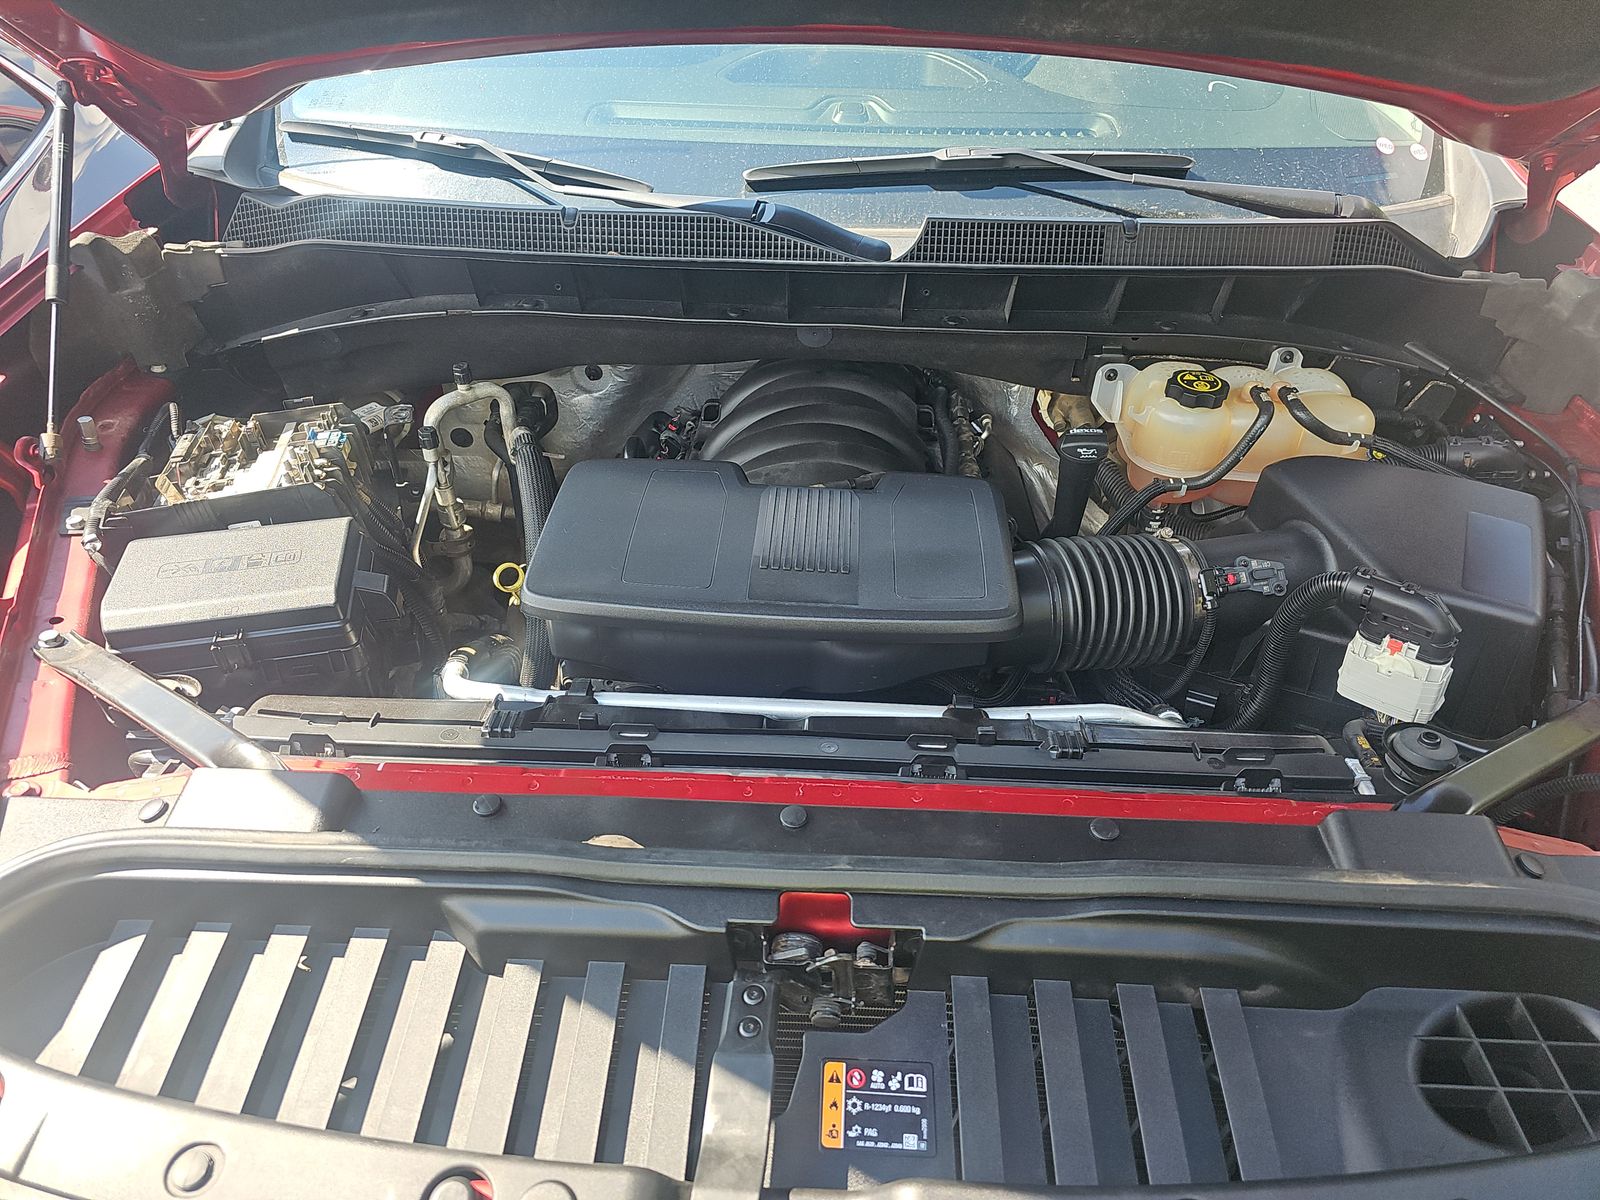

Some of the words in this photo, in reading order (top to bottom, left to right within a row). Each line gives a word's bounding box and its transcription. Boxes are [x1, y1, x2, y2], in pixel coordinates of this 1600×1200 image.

[870, 1082, 886, 1090] AUTO
[912, 1105, 921, 1115] kg
[864, 1127, 878, 1137] PAG
